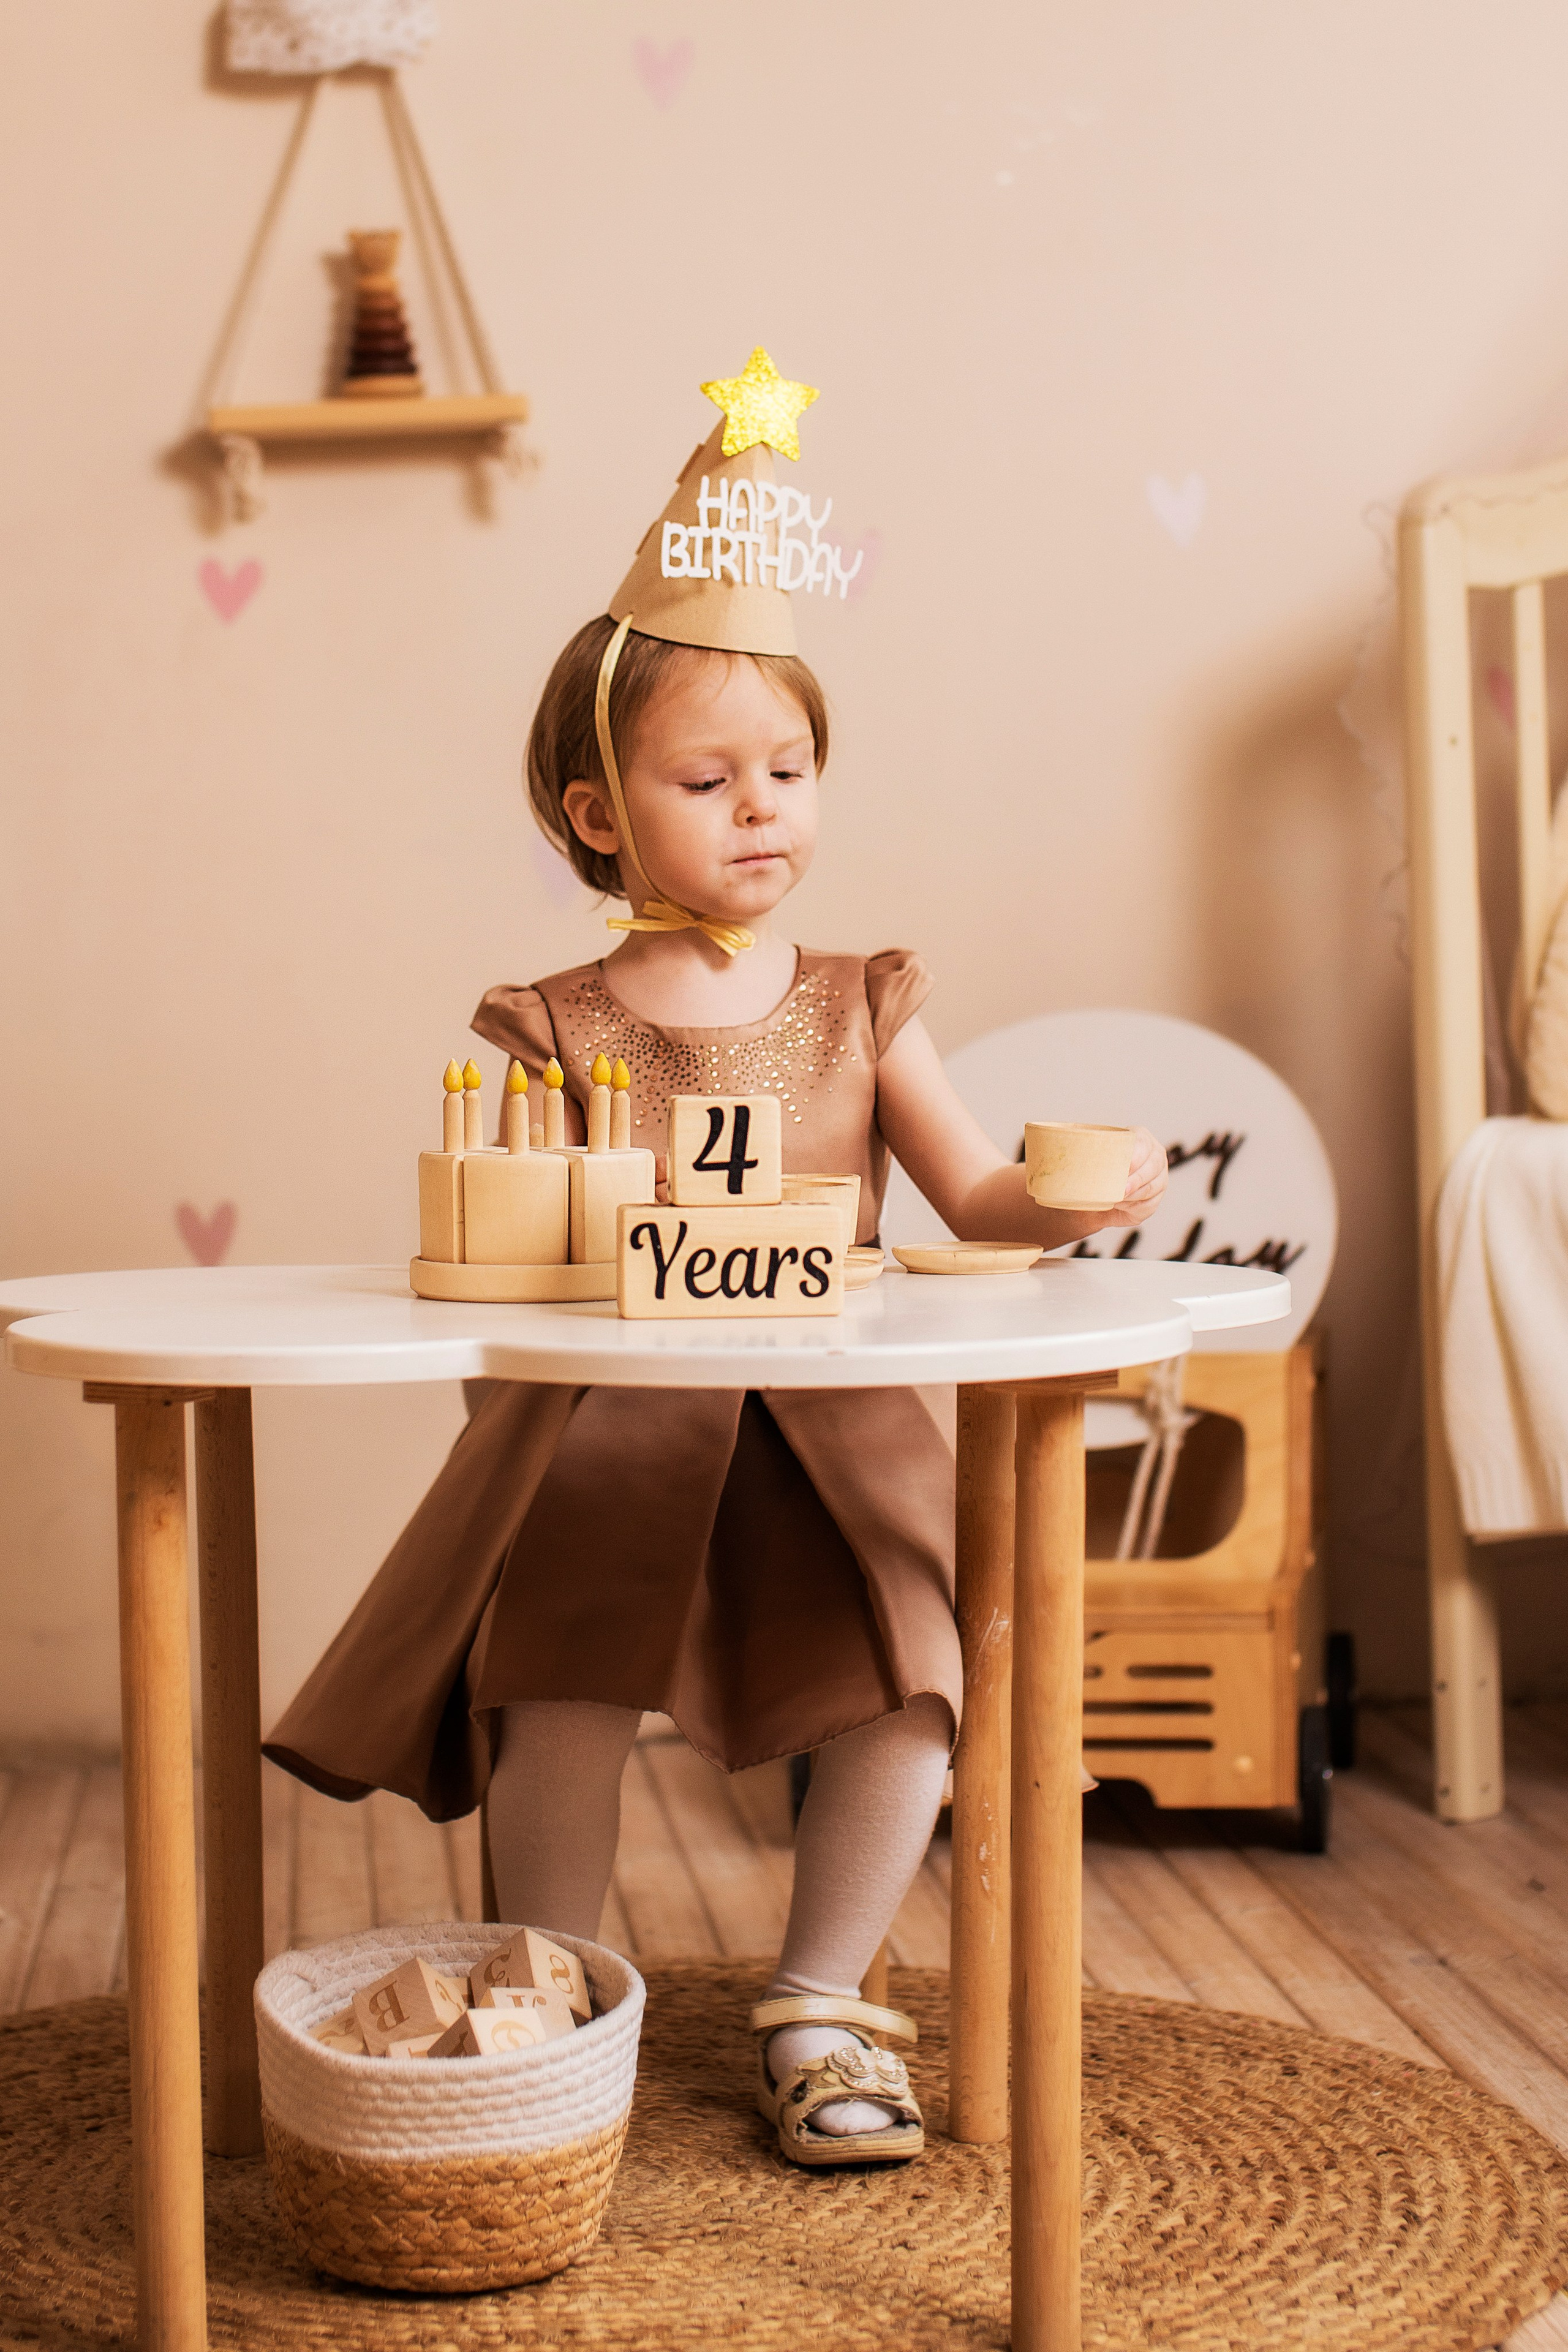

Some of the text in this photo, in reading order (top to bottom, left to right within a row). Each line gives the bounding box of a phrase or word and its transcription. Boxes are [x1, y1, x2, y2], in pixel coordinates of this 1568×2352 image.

[696, 475, 832, 548] HAPPY
[662, 521, 863, 599] BIRTHDAY
[692, 1105, 759, 1195] 4
[630, 1221, 833, 1299] Years
